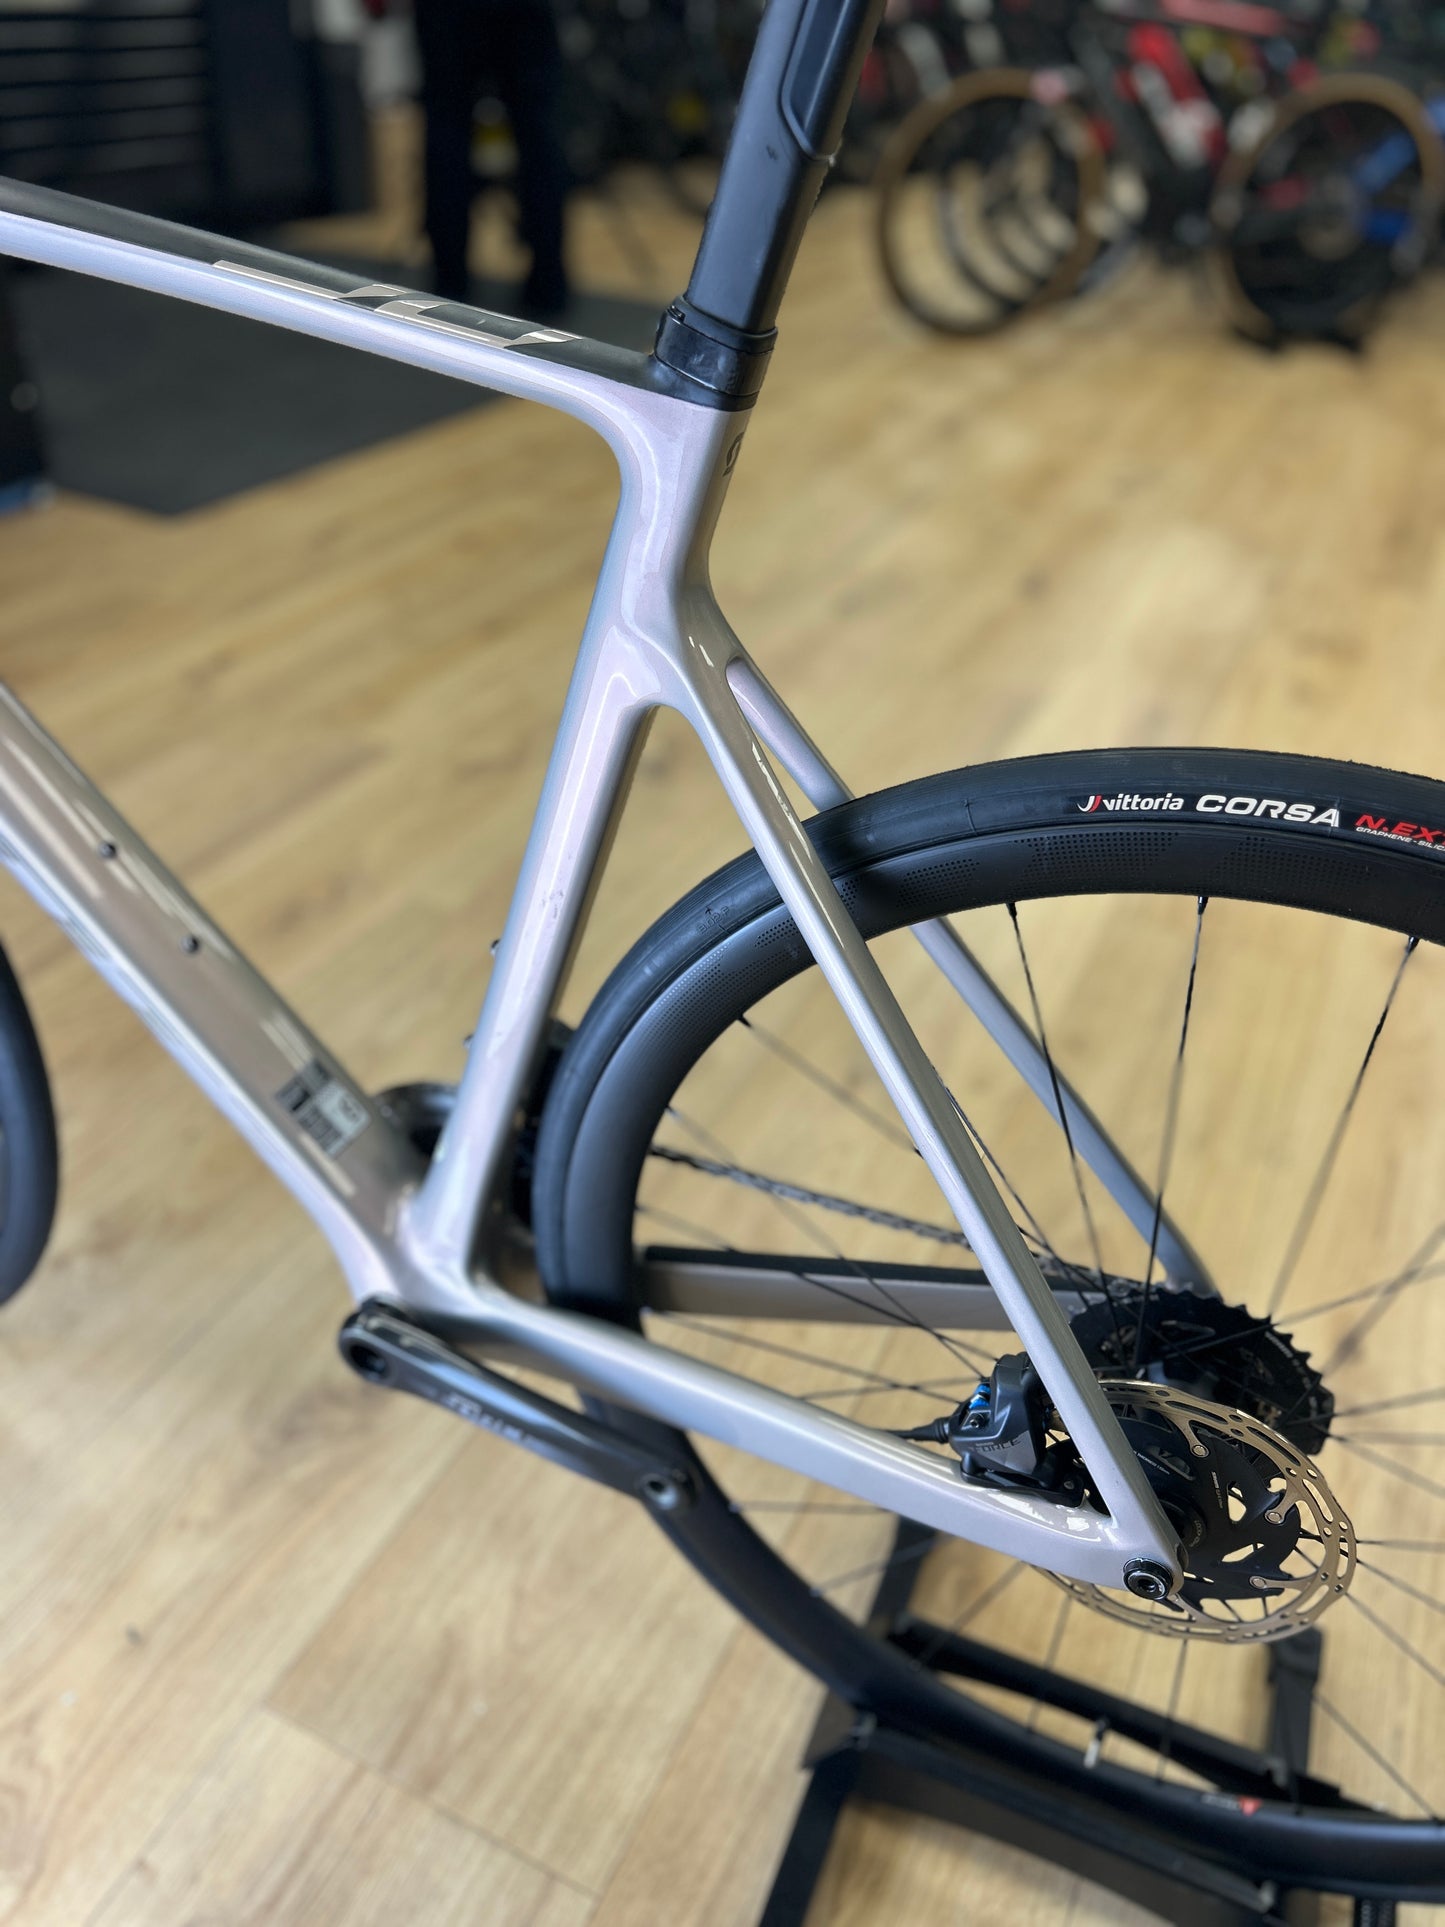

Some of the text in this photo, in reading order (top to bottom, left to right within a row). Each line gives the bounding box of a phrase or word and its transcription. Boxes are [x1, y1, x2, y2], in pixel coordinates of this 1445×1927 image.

[1102, 792, 1445, 843] vittoria CORSA N.EX
[1418, 839, 1445, 852] SILIC
